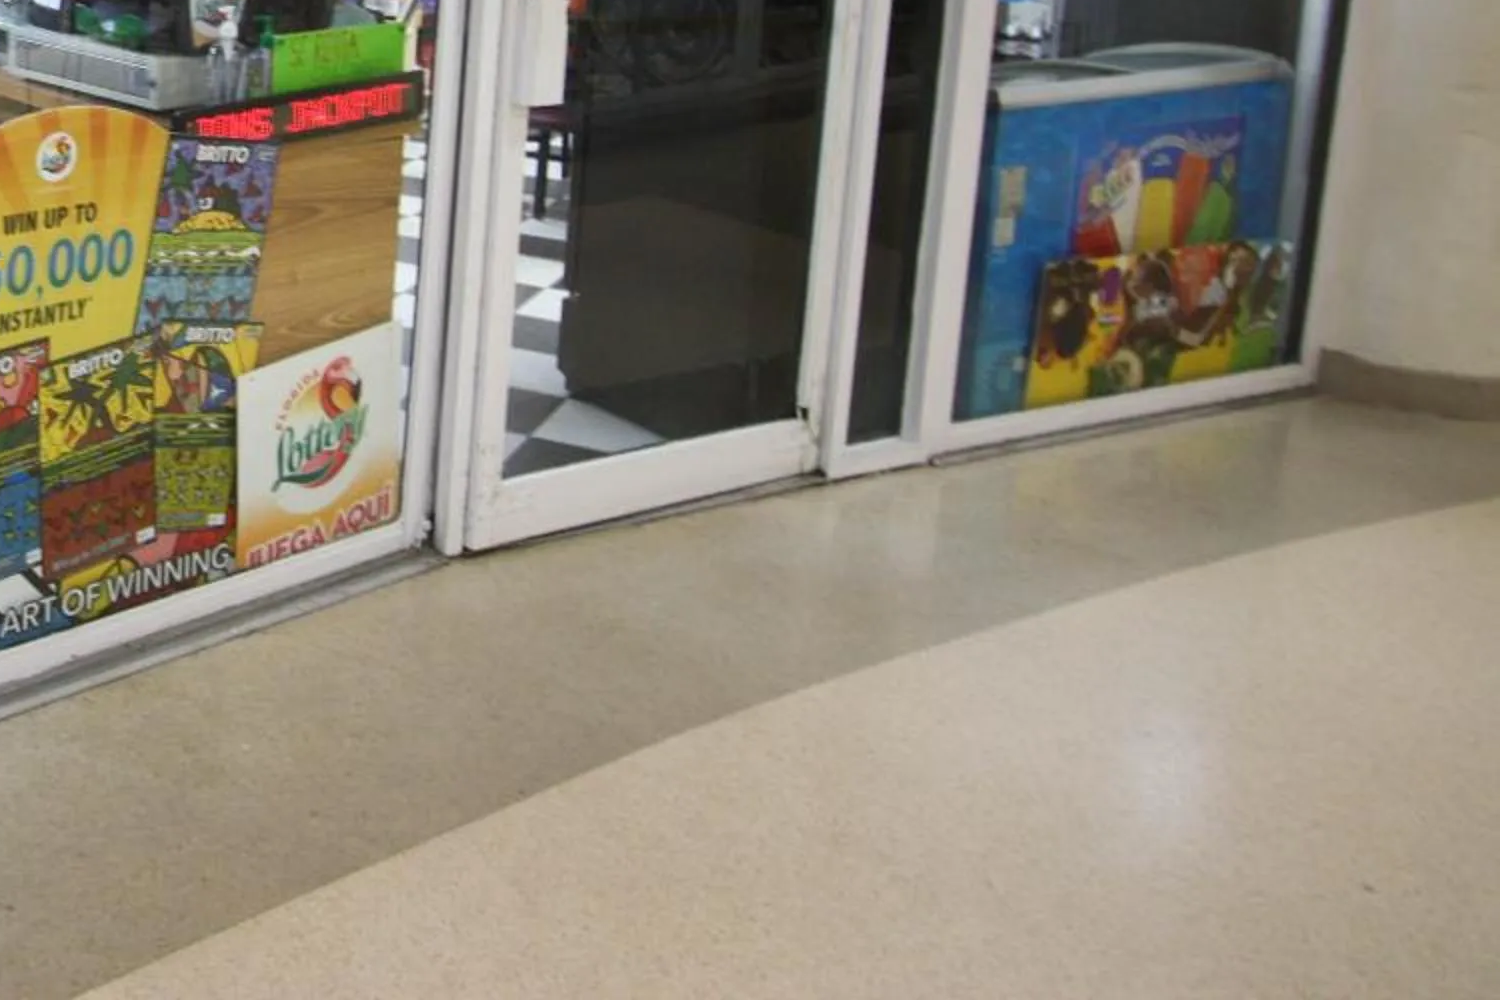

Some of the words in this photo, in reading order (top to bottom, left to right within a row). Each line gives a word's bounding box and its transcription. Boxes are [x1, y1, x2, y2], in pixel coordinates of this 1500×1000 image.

[195, 143, 250, 165] BRITTO
[2, 208, 40, 236] WIN
[44, 204, 71, 231] UP
[74, 202, 98, 226] TO
[185, 325, 236, 346] BRITTO
[68, 347, 124, 380] BRITTO
[270, 403, 370, 493] Lottery
[0, 596, 57, 638] ART
[60, 582, 112, 617] OF
[106, 541, 232, 604] WINNING
